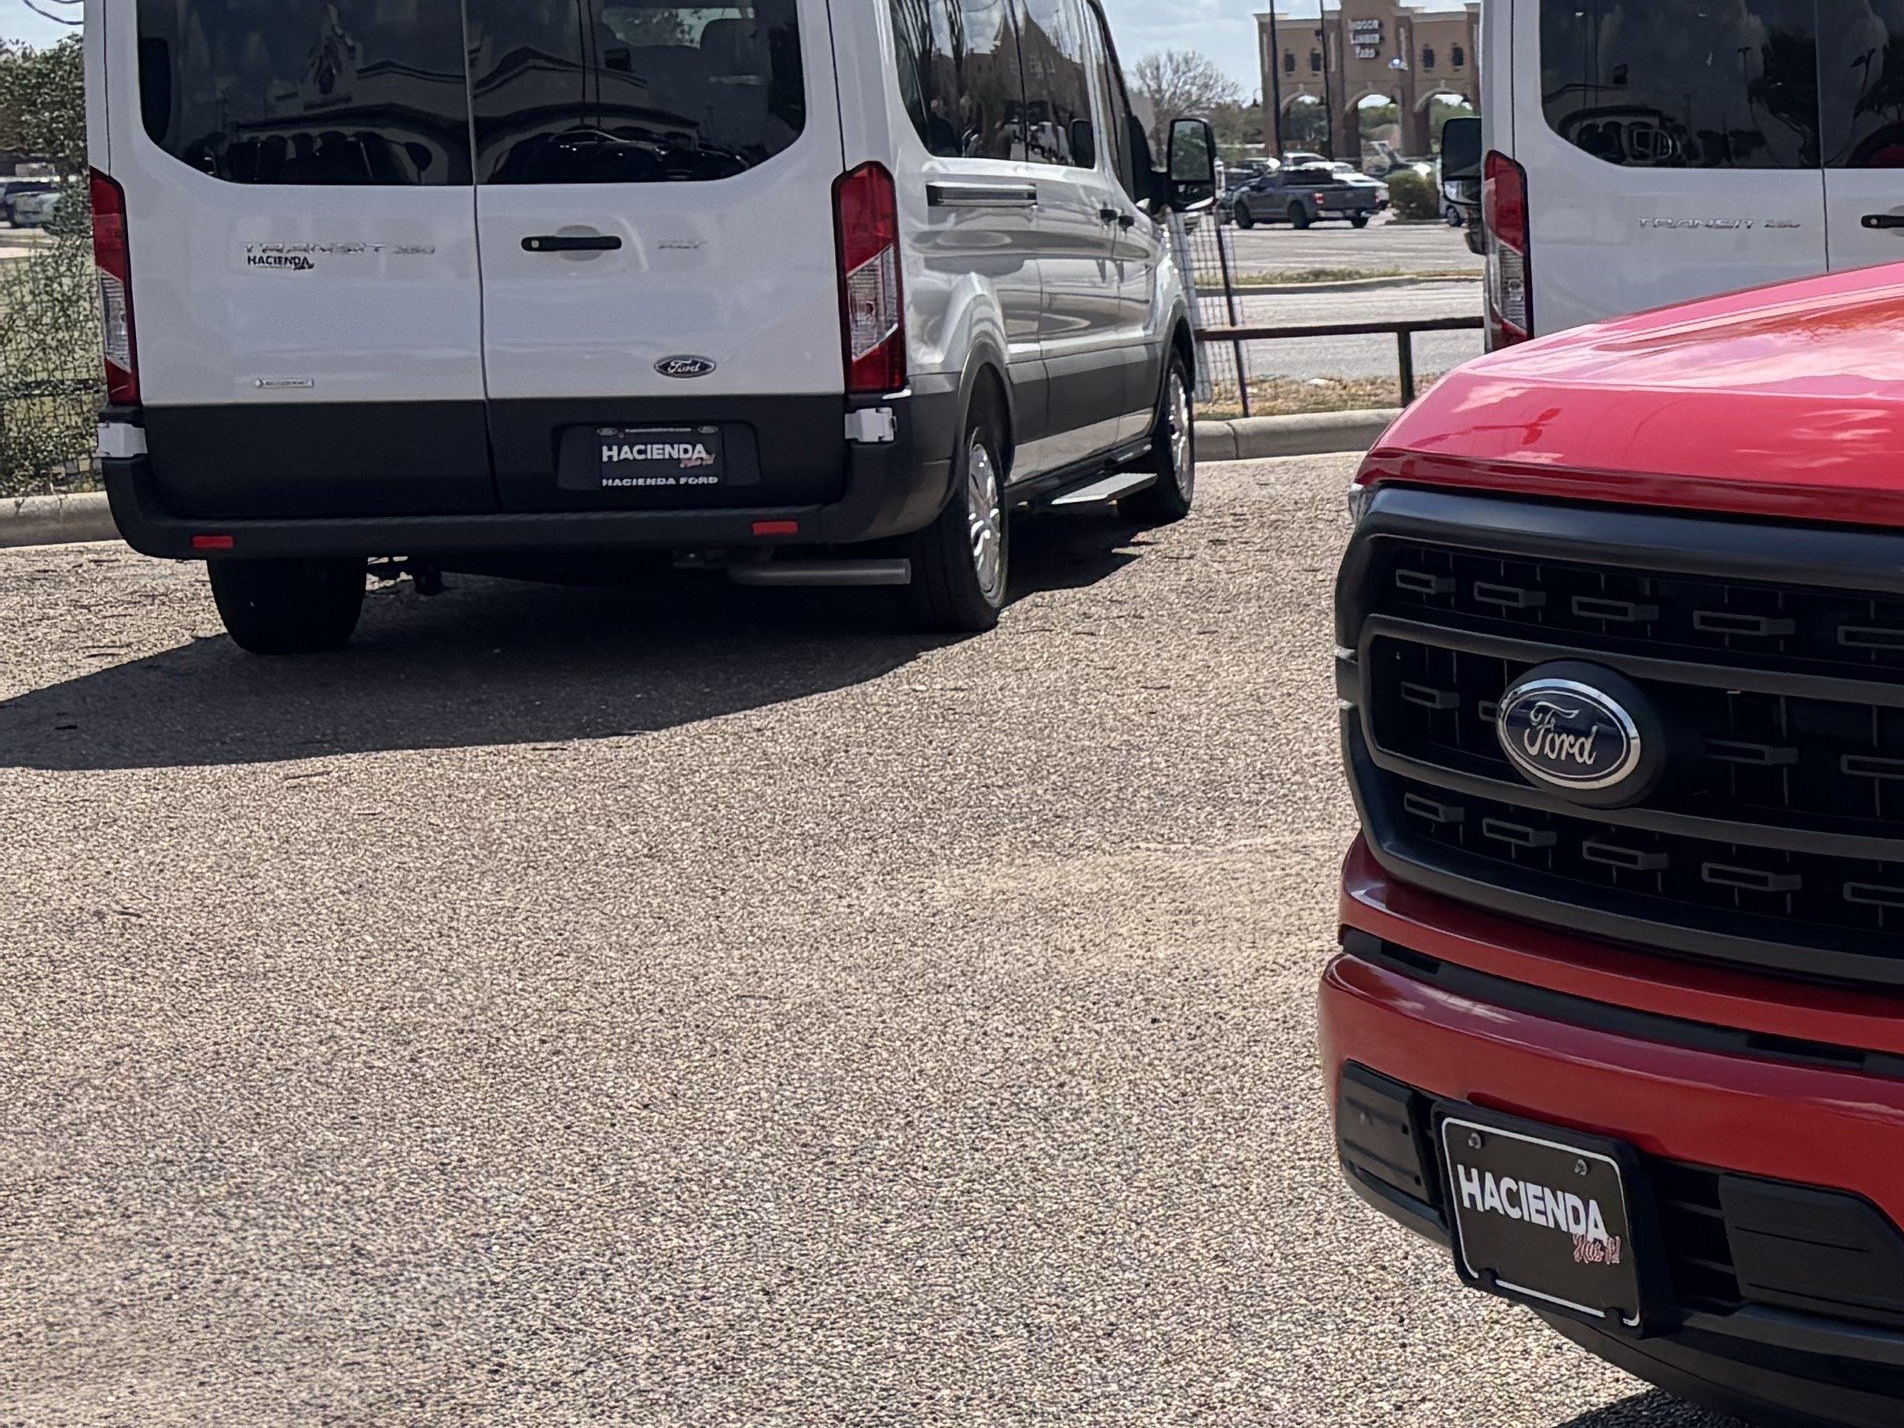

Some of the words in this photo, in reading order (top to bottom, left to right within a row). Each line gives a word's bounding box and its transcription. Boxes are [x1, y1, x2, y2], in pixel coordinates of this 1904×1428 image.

[602, 443, 708, 462] HACIENDA
[602, 477, 677, 487] HACIENDA
[679, 476, 719, 485] FORD
[1523, 700, 1599, 766] Ford
[1457, 1164, 1610, 1247] HACIENDA
